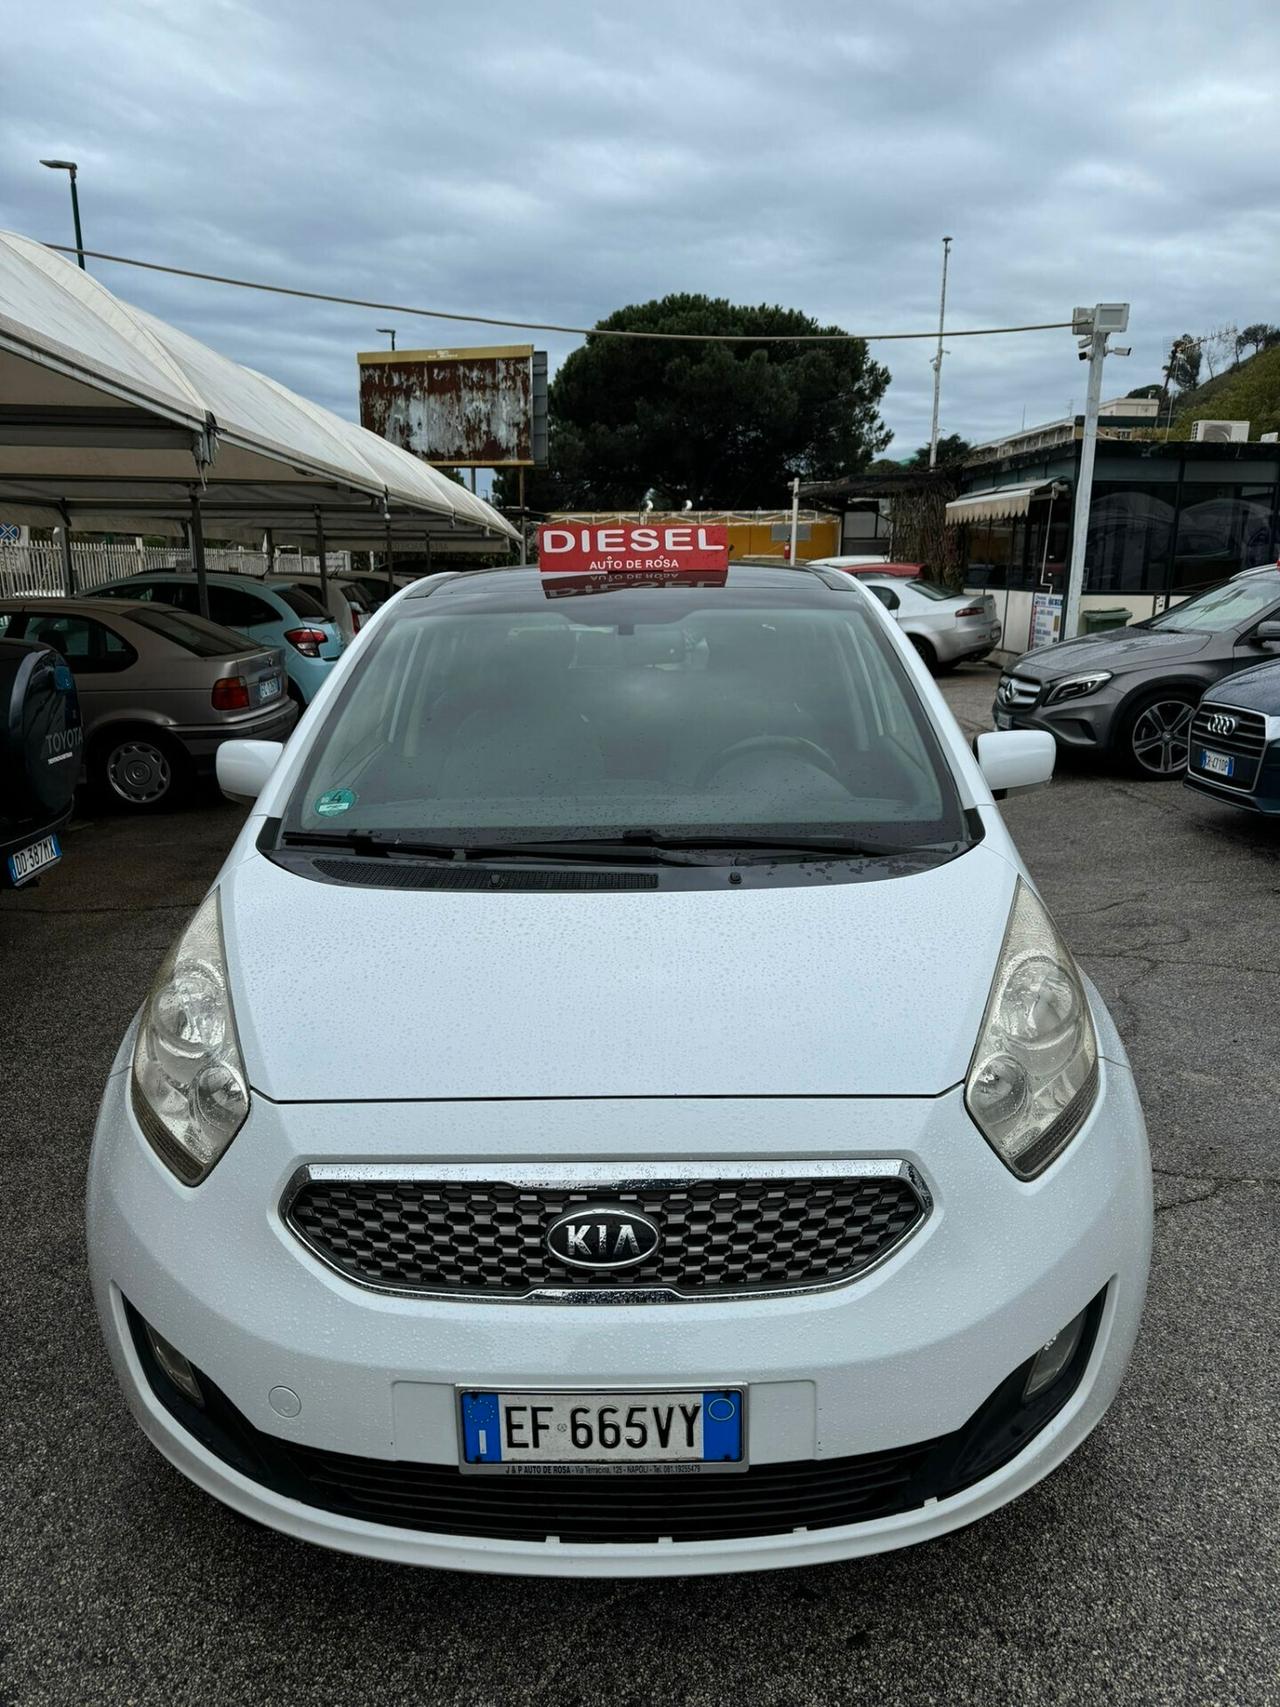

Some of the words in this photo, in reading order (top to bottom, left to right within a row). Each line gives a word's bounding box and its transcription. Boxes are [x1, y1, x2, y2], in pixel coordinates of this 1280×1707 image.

[543, 528, 725, 553] DIESEL
[589, 560, 623, 570] AUTO
[626, 560, 642, 569] DE
[645, 559, 679, 568] ROSA
[45, 727, 84, 754] TOYOTA
[15, 853, 28, 876] DD
[28, 838, 56, 867] 387MX
[565, 1224, 641, 1255] KIA
[505, 1406, 554, 1448] EF
[570, 1404, 701, 1449] 665VY
